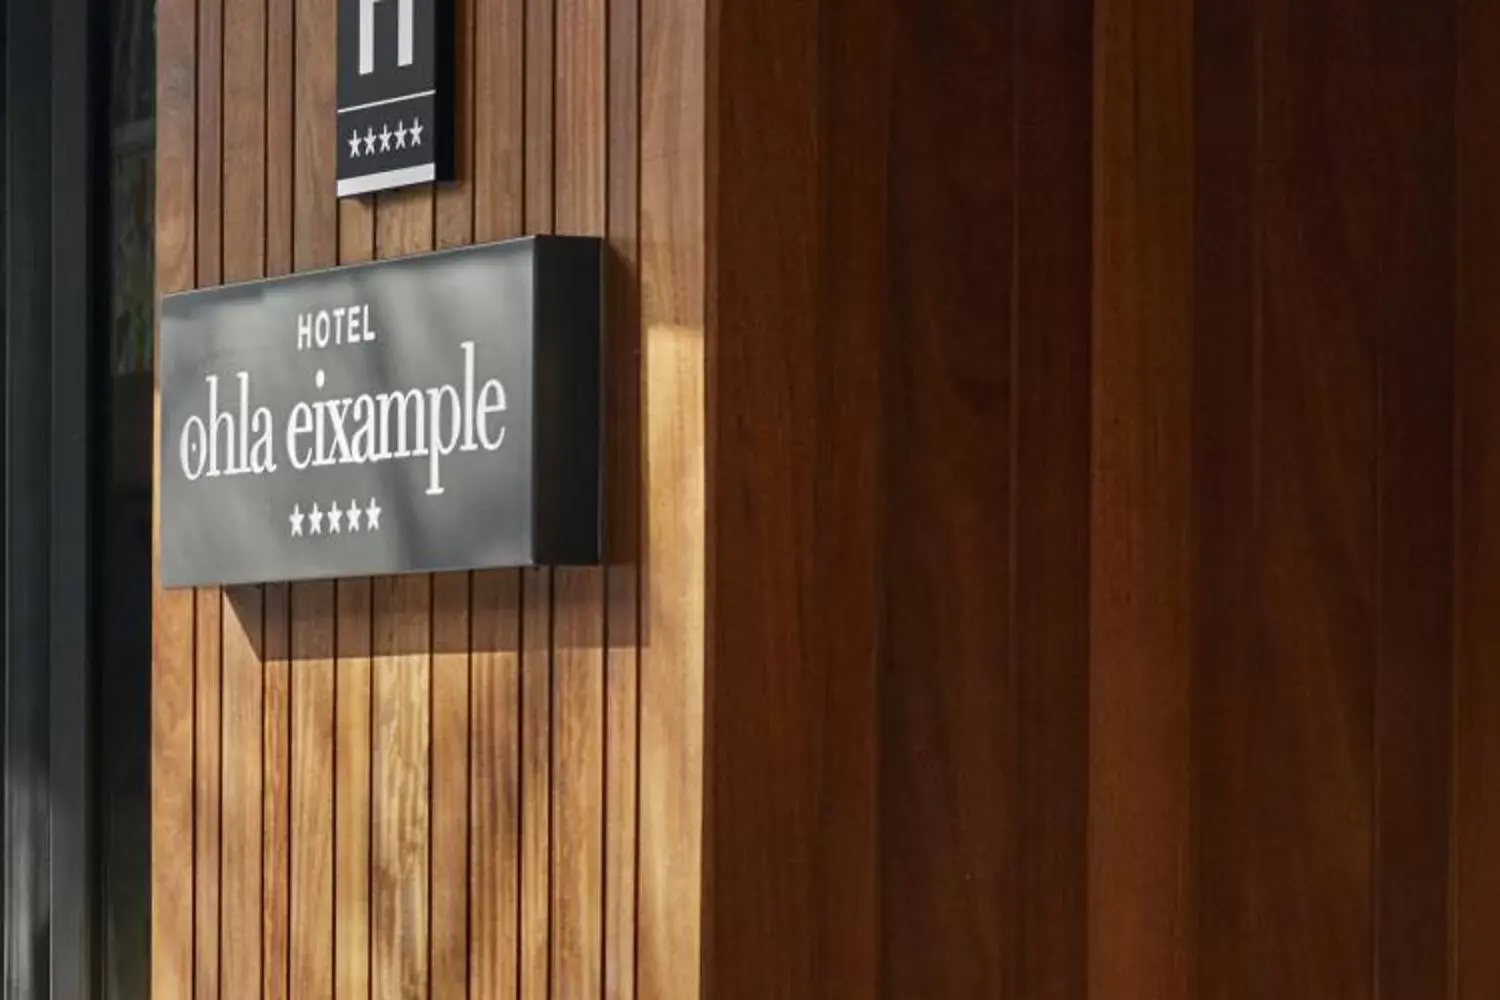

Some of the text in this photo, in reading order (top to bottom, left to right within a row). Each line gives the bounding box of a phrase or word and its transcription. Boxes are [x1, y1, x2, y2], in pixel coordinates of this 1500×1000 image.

[297, 304, 375, 350] HOTEL
[180, 341, 506, 495] ohla eixample
